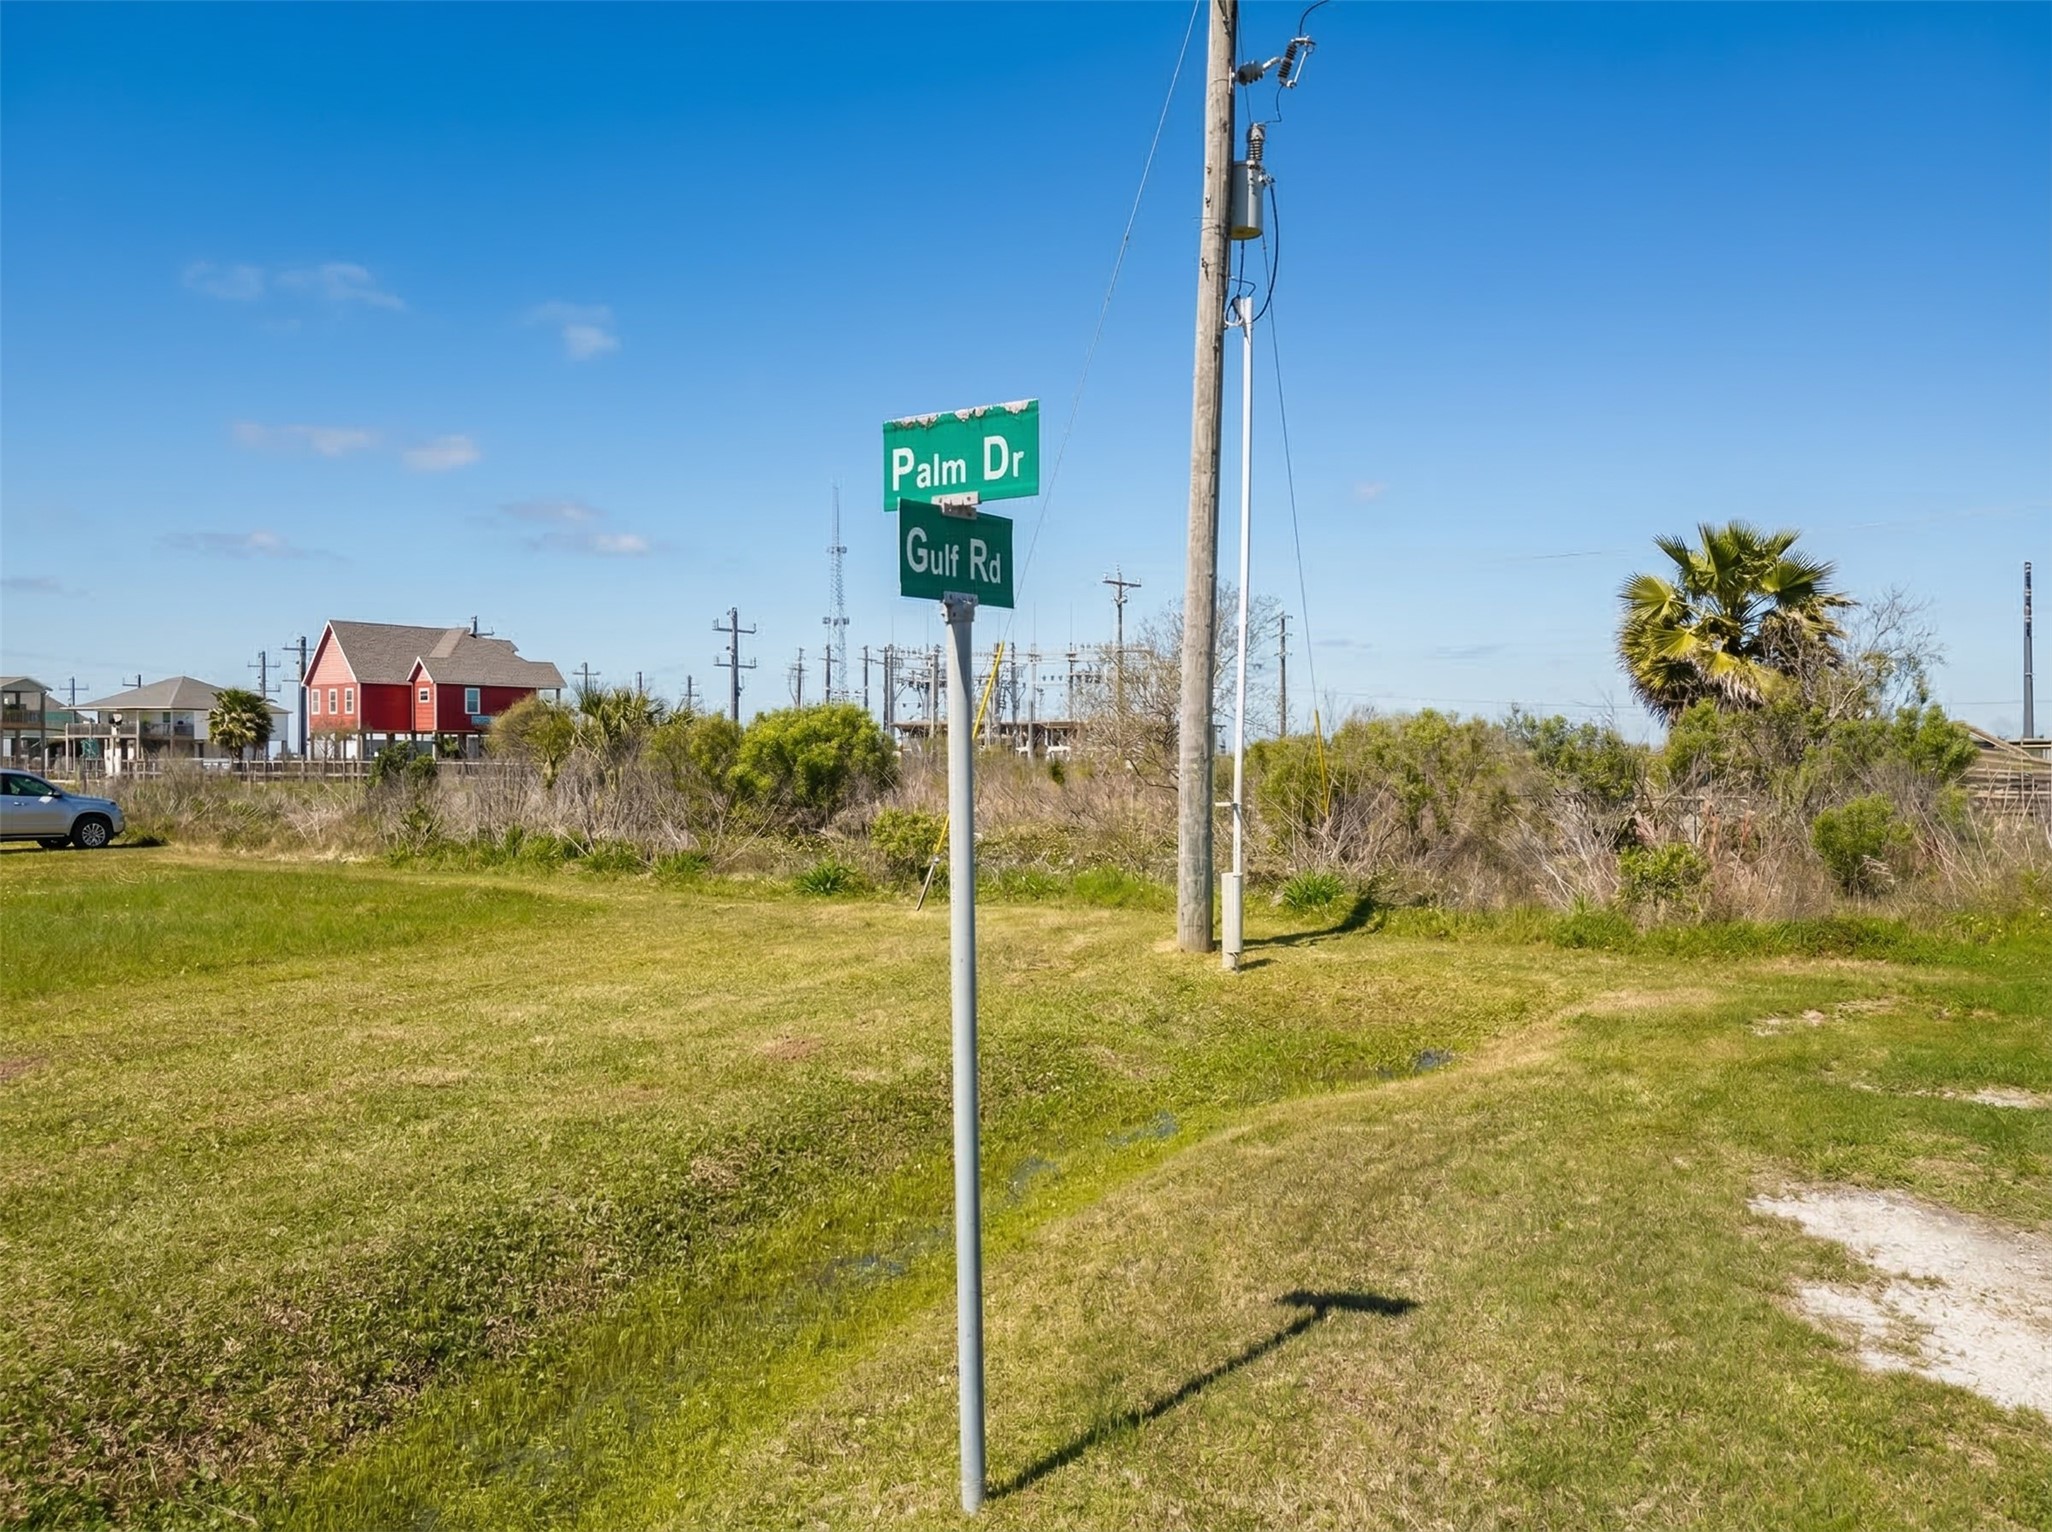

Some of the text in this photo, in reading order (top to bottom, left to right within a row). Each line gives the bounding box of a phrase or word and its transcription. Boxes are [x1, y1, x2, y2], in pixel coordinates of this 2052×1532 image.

[892, 435, 1025, 491] Palm Dr
[906, 527, 1001, 584] Gulf Rd
